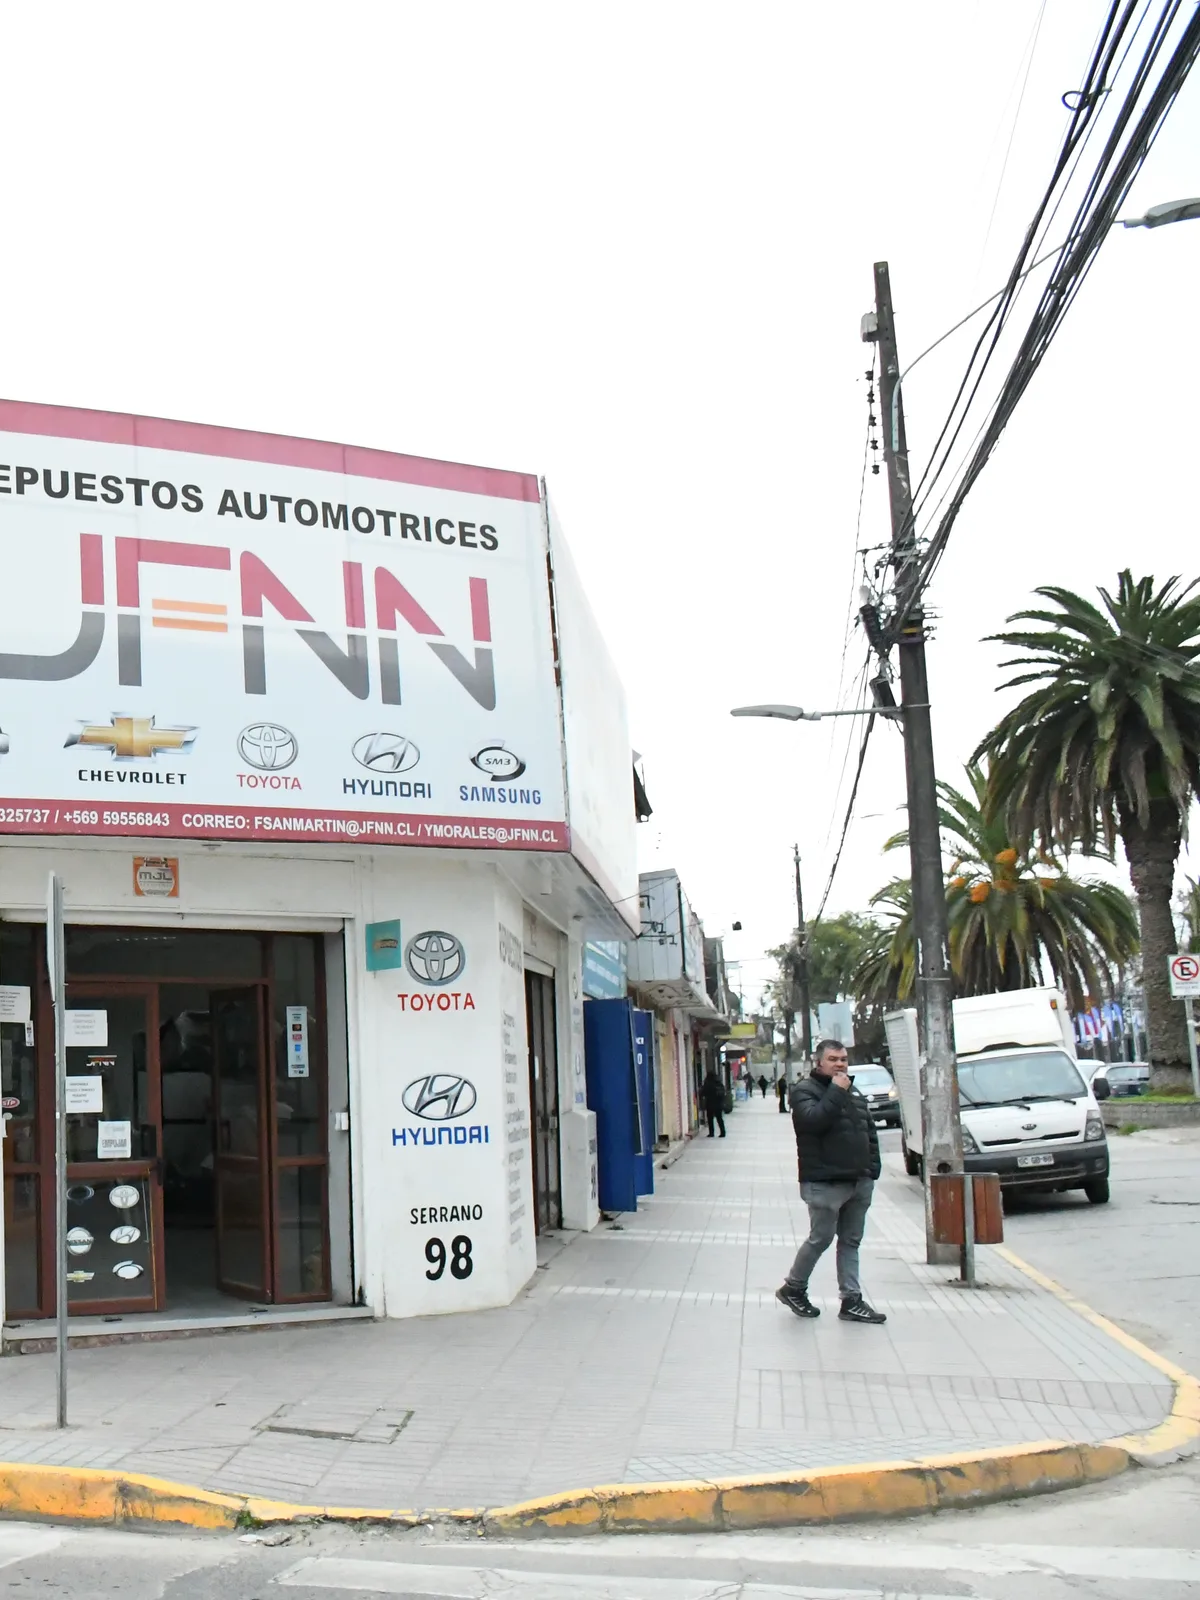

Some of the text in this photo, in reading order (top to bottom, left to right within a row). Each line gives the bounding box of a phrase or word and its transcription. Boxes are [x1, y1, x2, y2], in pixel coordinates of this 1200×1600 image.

[217, 489, 499, 551] AUTOMOTRICES
[485, 758, 511, 766] SM3
[78, 769, 187, 785] CHEVROLET
[236, 774, 302, 791] TOYOTA
[342, 778, 432, 799] HYUNDAI
[459, 785, 542, 806] SAMSUNG
[54, 809, 60, 824] /
[63, 810, 99, 825] +569
[102, 811, 170, 827] 59556843
[181, 813, 250, 830] CORREO:
[254, 815, 414, 837] FSANMARTIN@JFNN.CL
[424, 824, 559, 843] YMORALES@JFNN.CL
[397, 992, 476, 1012] TOYOTA
[391, 1125, 490, 1147] HYUNDAI
[409, 1203, 484, 1225] SERRANO
[424, 1234, 474, 1281] 98
